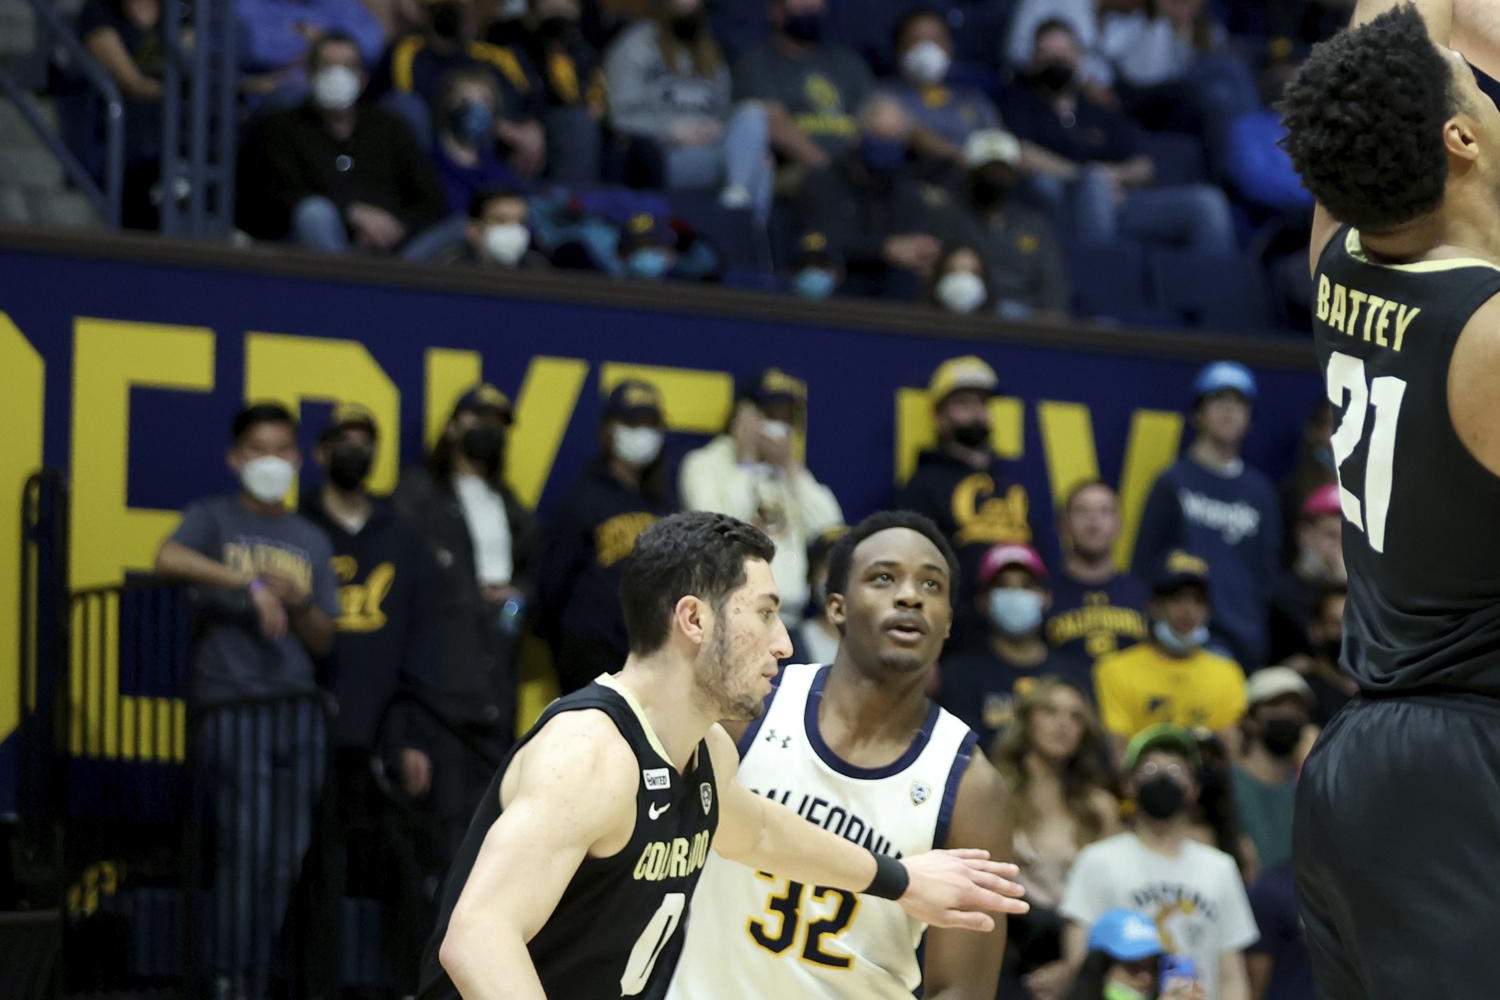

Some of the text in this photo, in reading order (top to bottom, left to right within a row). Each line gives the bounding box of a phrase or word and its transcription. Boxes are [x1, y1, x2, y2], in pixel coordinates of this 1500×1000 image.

[1315, 272, 1422, 352] BATTEY
[1326, 350, 1407, 554] 21
[633, 828, 711, 882] CORDO
[750, 787, 905, 861] IFORN
[620, 892, 686, 997] 0
[747, 868, 860, 970] 32
